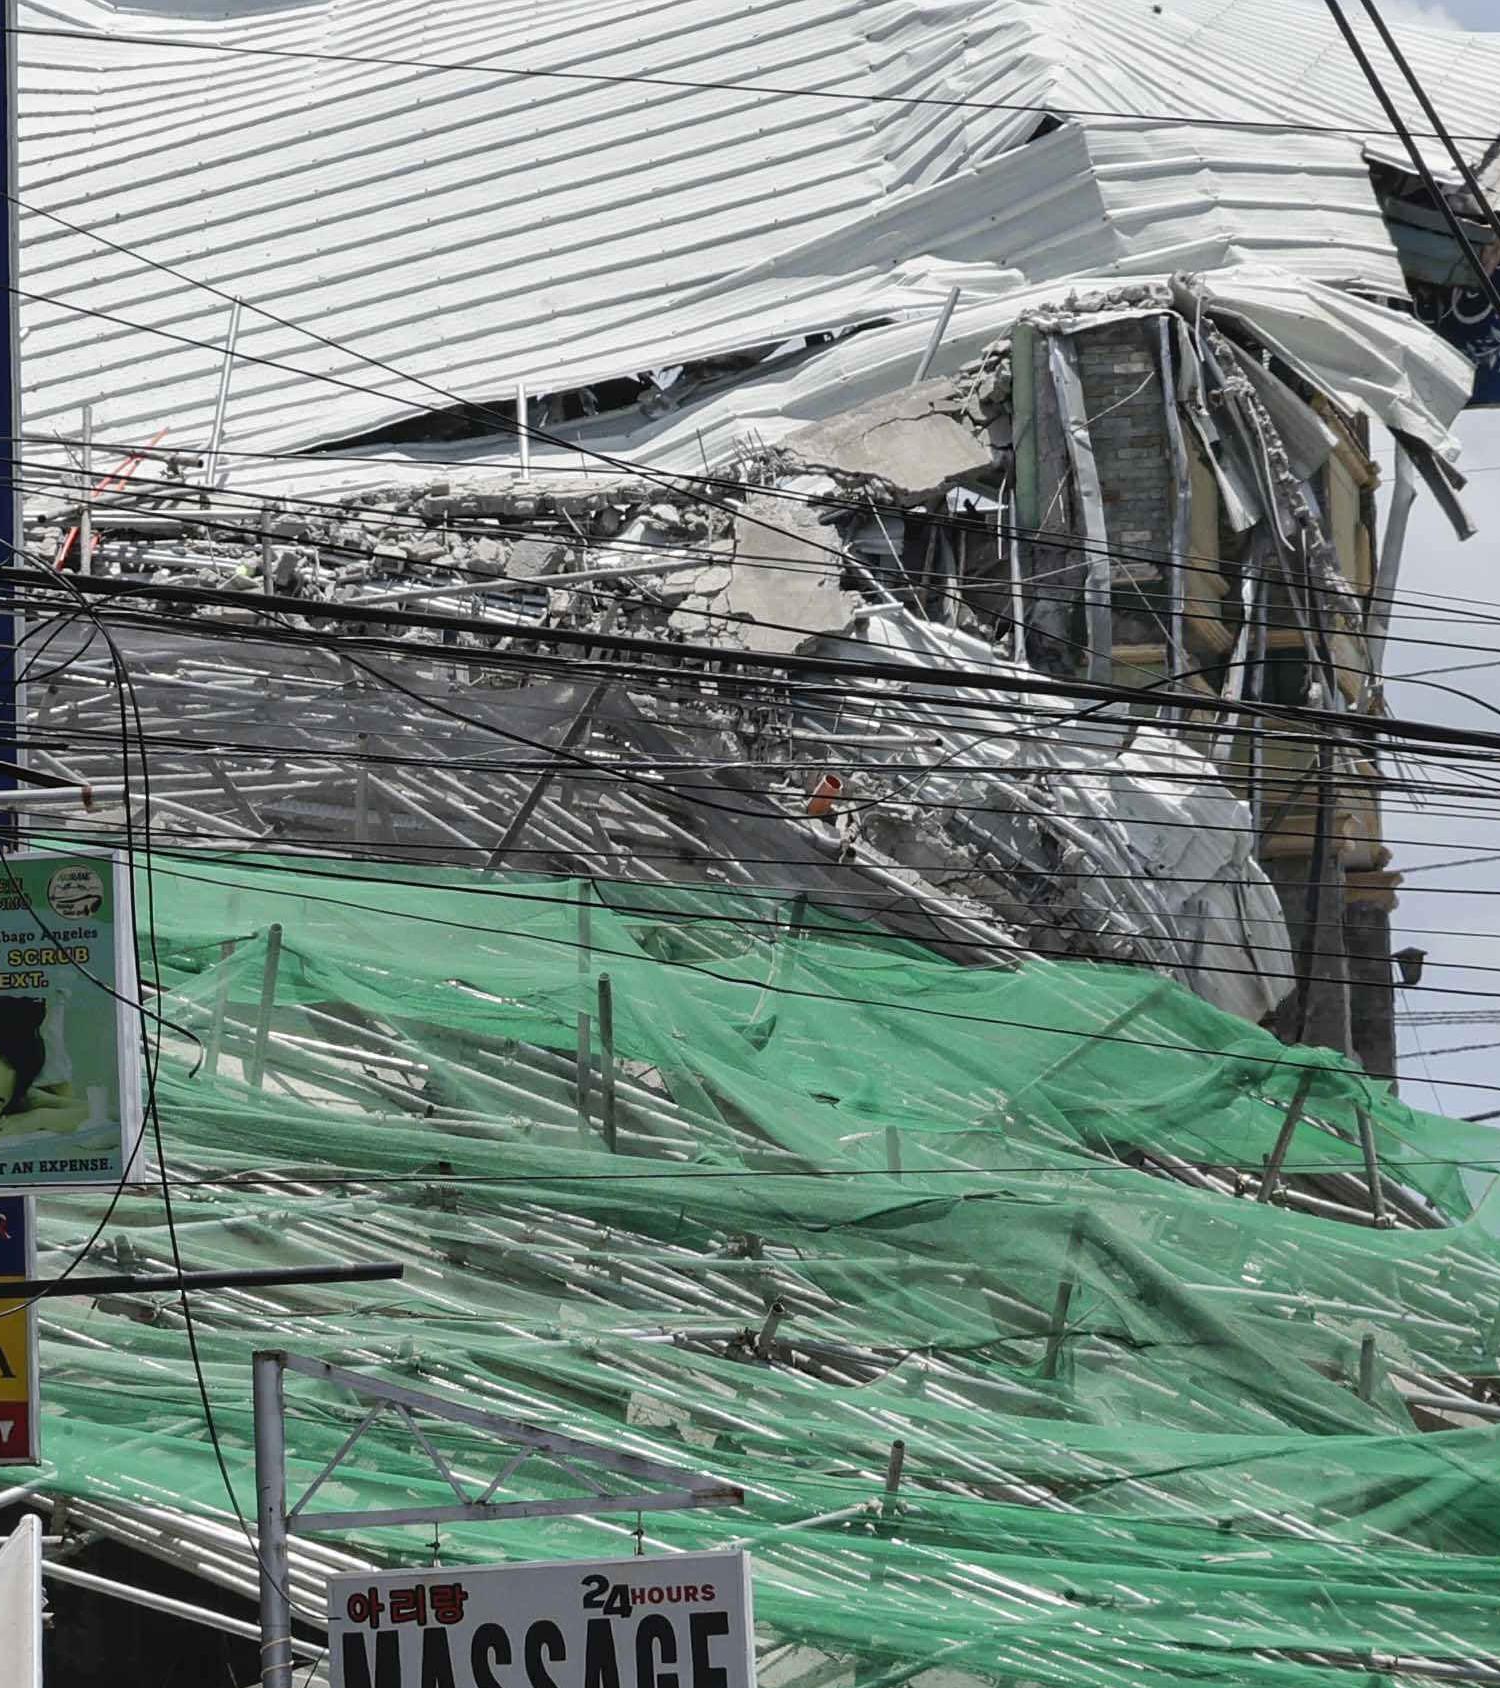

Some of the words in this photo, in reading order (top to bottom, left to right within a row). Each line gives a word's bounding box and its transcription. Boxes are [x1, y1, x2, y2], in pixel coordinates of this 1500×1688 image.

[42, 927, 98, 943] Angeles
[8, 947, 89, 967] SCRUB
[12, 1159, 35, 1176] AN
[38, 1157, 114, 1175] EXPENSE.
[347, 1582, 469, 1629] 아리랑
